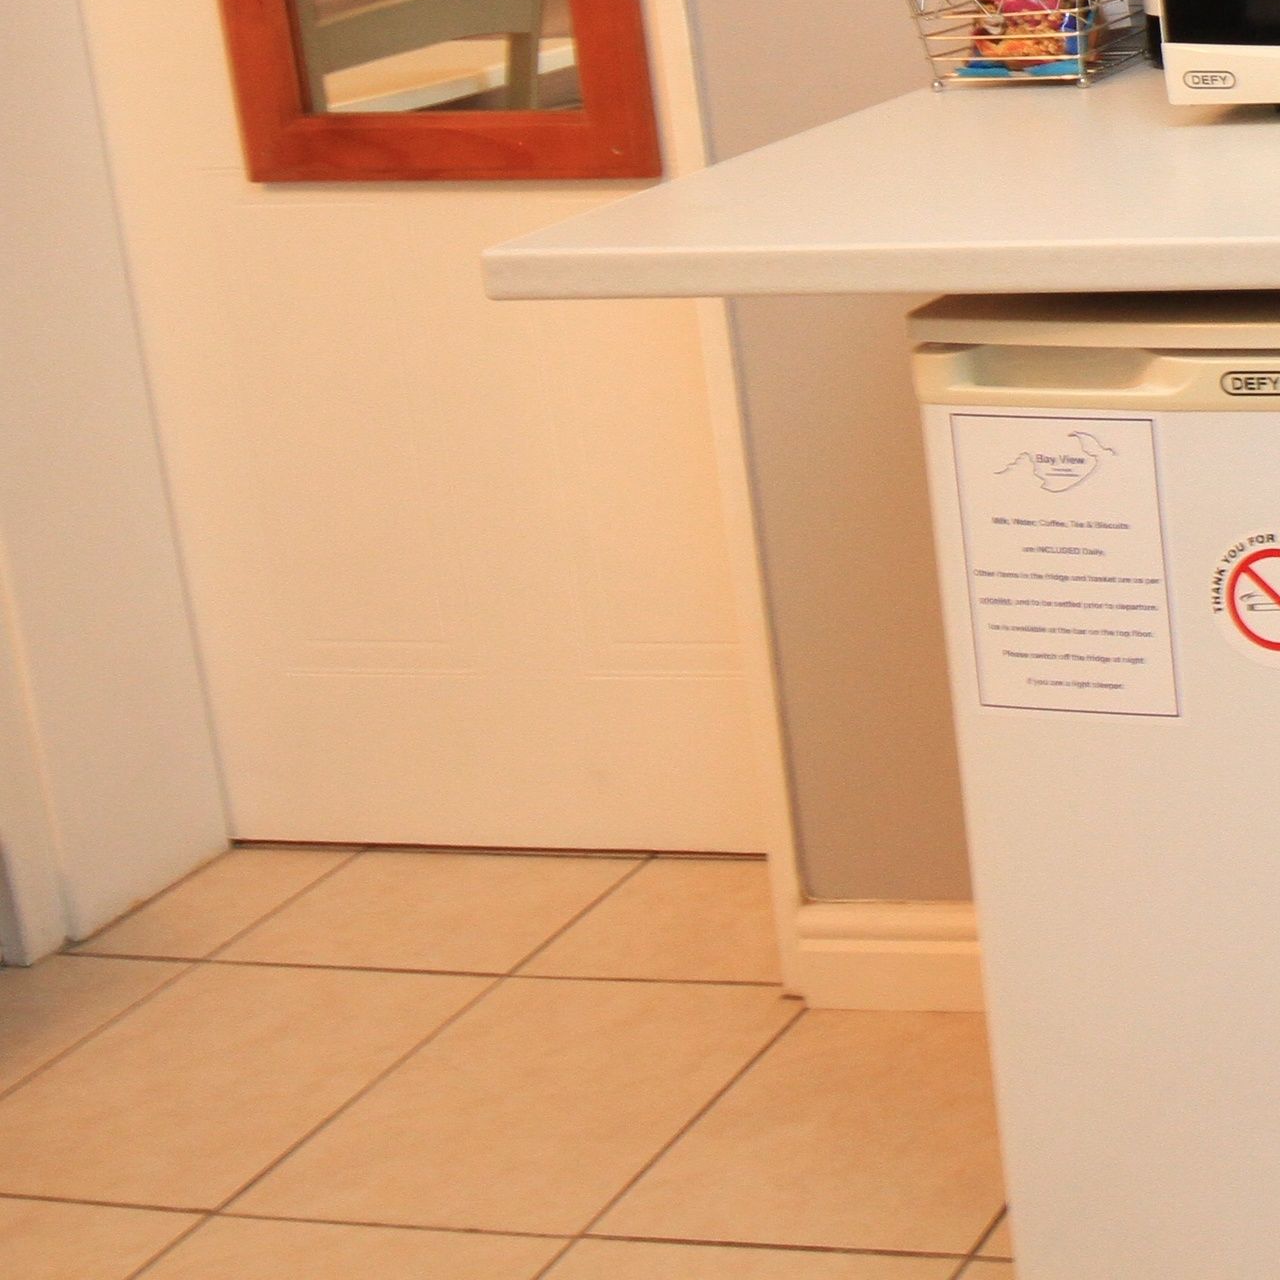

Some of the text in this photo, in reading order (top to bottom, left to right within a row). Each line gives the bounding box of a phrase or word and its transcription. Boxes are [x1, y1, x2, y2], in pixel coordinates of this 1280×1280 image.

[1192, 75, 1227, 85] DEFY
[1232, 377, 1279, 390] DEFY
[1036, 454, 1085, 465] Bay View
[1037, 546, 1079, 555] INCLUDED
[1210, 567, 1226, 614] THANK
[1221, 542, 1246, 564] YOU
[1246, 534, 1276, 546] FOR
[1003, 649, 1028, 658] Please
